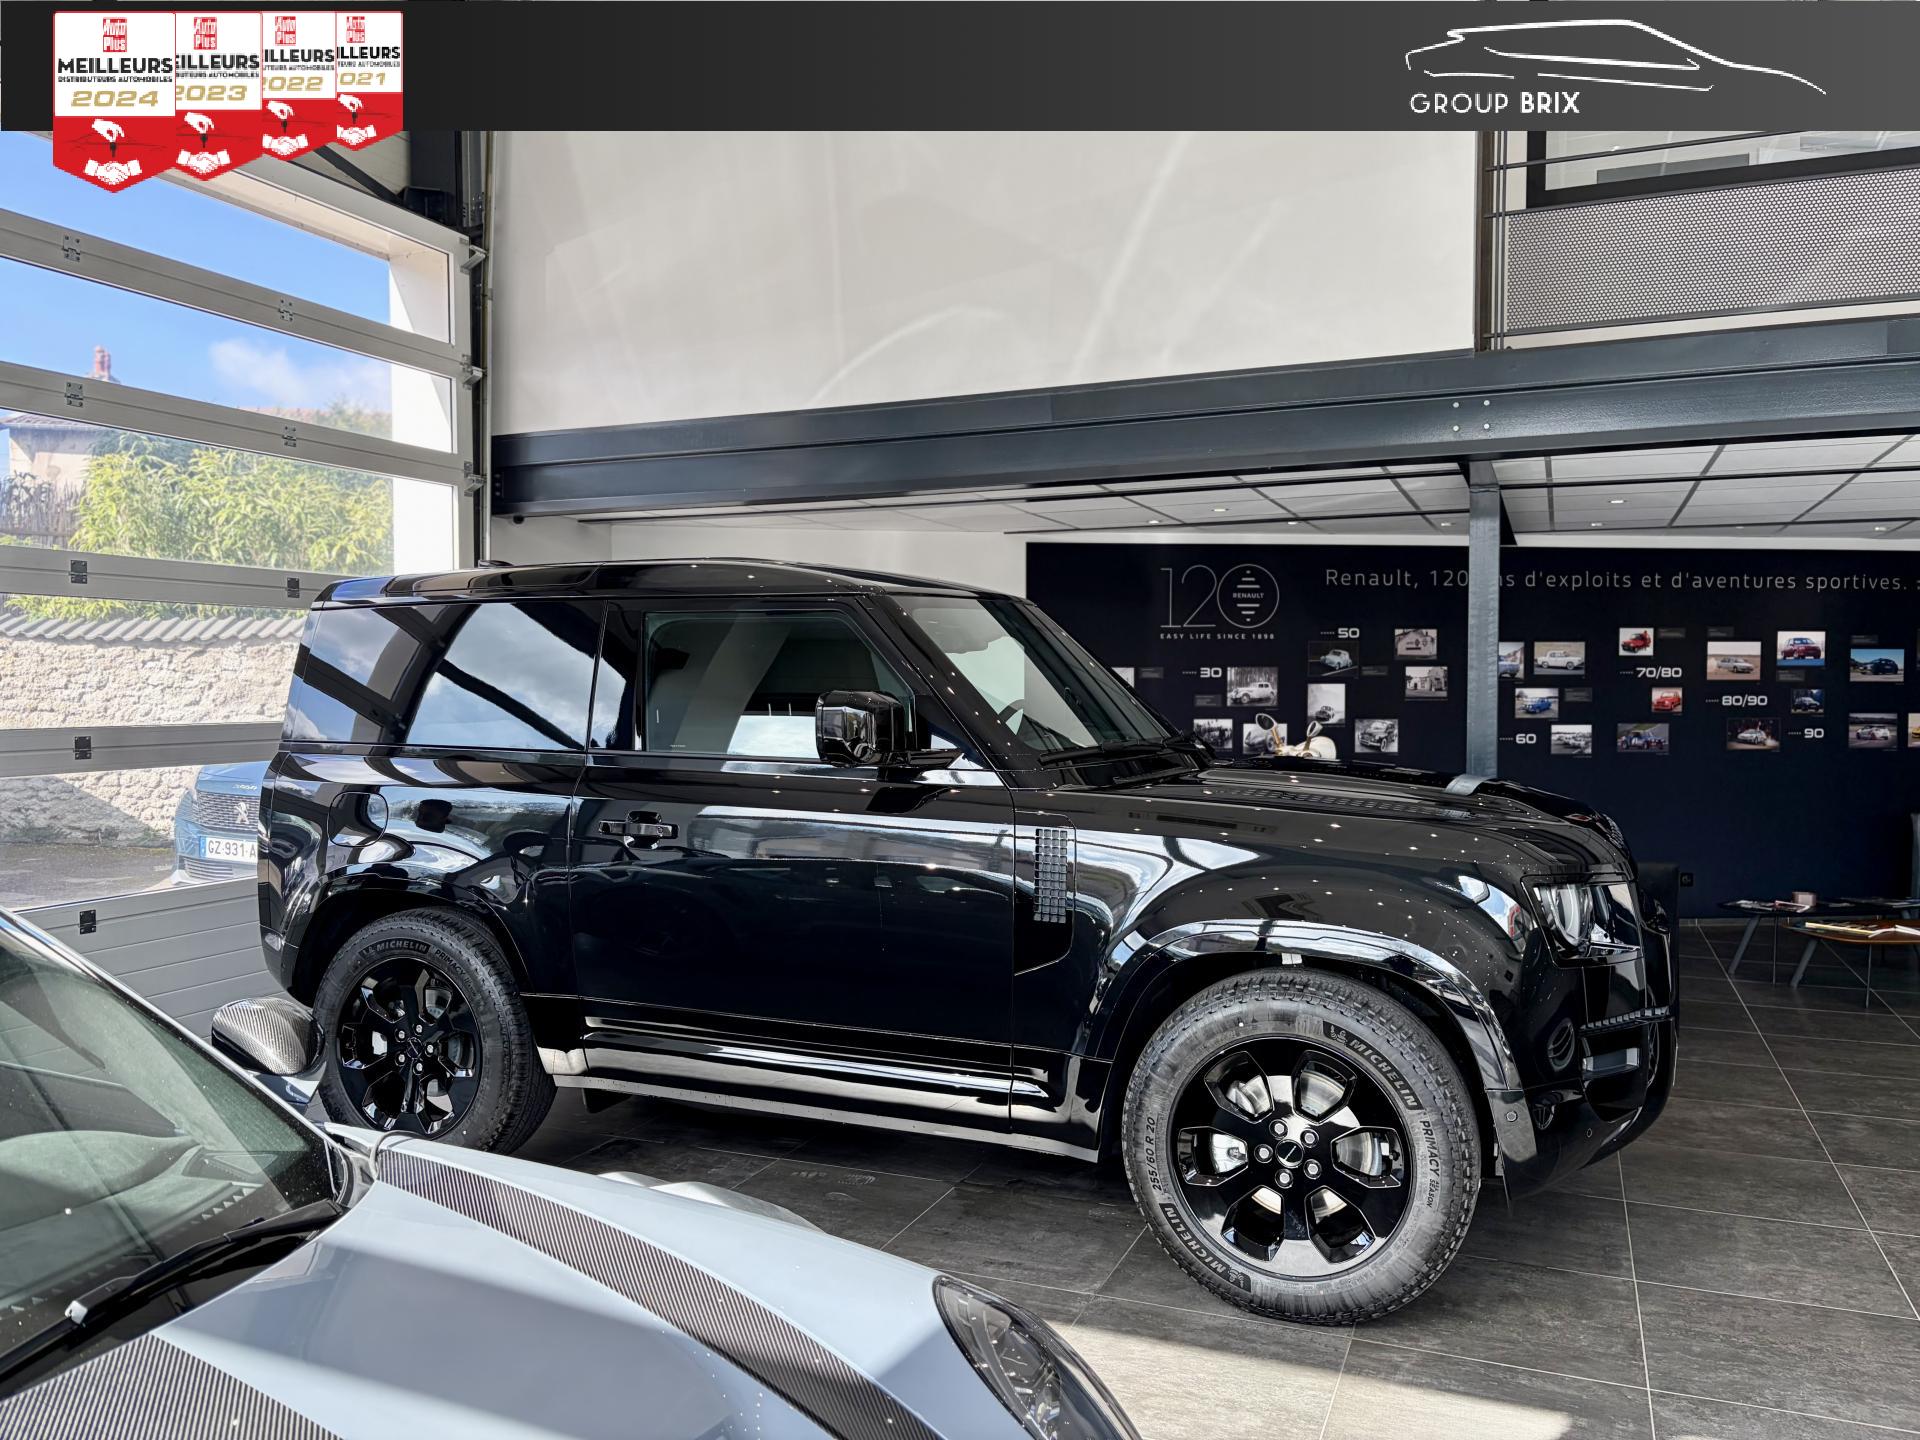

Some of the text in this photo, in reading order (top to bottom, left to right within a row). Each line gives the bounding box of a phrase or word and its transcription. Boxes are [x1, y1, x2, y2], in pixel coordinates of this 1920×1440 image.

[1325, 568, 1419, 589] Renault,
[1430, 570, 1469, 587] 120
[1525, 571, 1632, 591] d'exploits
[1641, 573, 1662, 588] et
[1671, 572, 1797, 589] d'aventures
[1806, 574, 1907, 592] sportives.
[1233, 592, 1265, 600] RENAULT
[1337, 627, 1360, 639] 50
[1199, 667, 1222, 678] 30
[1635, 665, 1683, 680] 70/80
[1721, 694, 1768, 708] 80/90
[1515, 733, 1537, 745] 60
[1804, 728, 1825, 739] 90
[376, 939, 428, 952] MICHELIN
[434, 949, 467, 976] PRIMACY
[1349, 1039, 1418, 1107] MICHELIN
[1145, 1116, 1163, 1192] 255/60 R 20
[1419, 1120, 1440, 1177] PRIMACY
[1426, 1178, 1437, 1208] SEASON
[1164, 1207, 1227, 1273] MICHELIN
